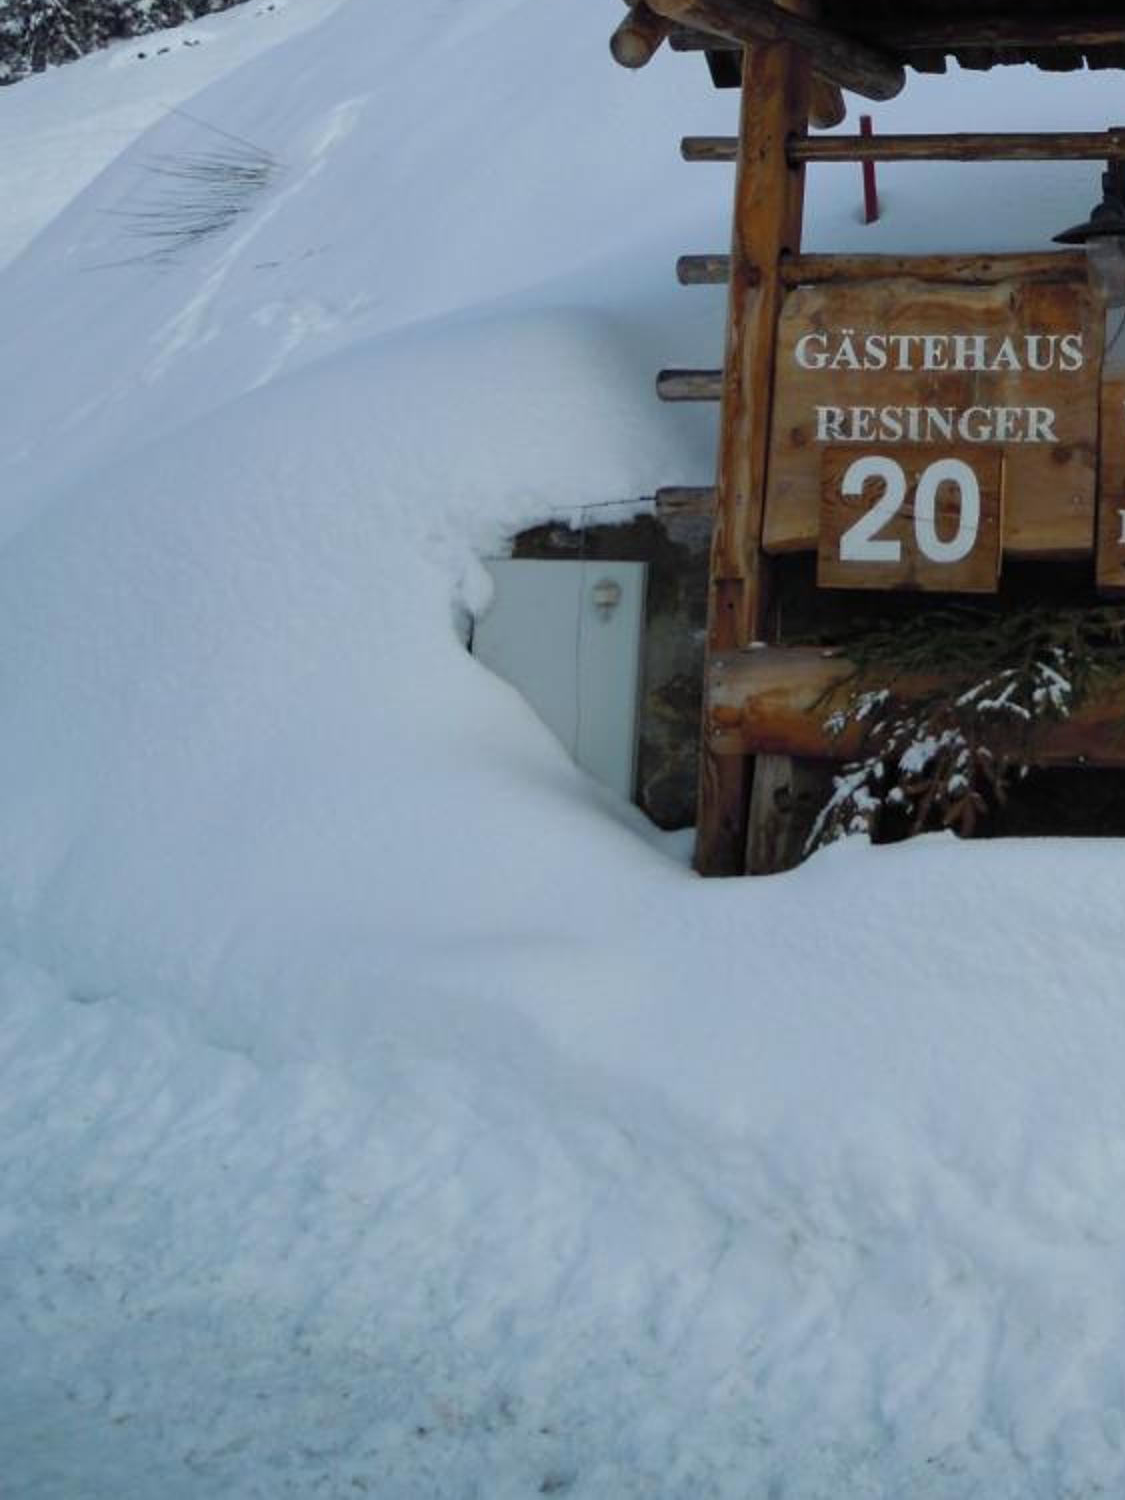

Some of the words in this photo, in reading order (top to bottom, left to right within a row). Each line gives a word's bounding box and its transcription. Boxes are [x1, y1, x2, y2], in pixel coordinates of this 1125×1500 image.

[794, 328, 1084, 372] GÄSTEHAUS
[814, 405, 1059, 443] RESINGER
[839, 455, 981, 564] 20
